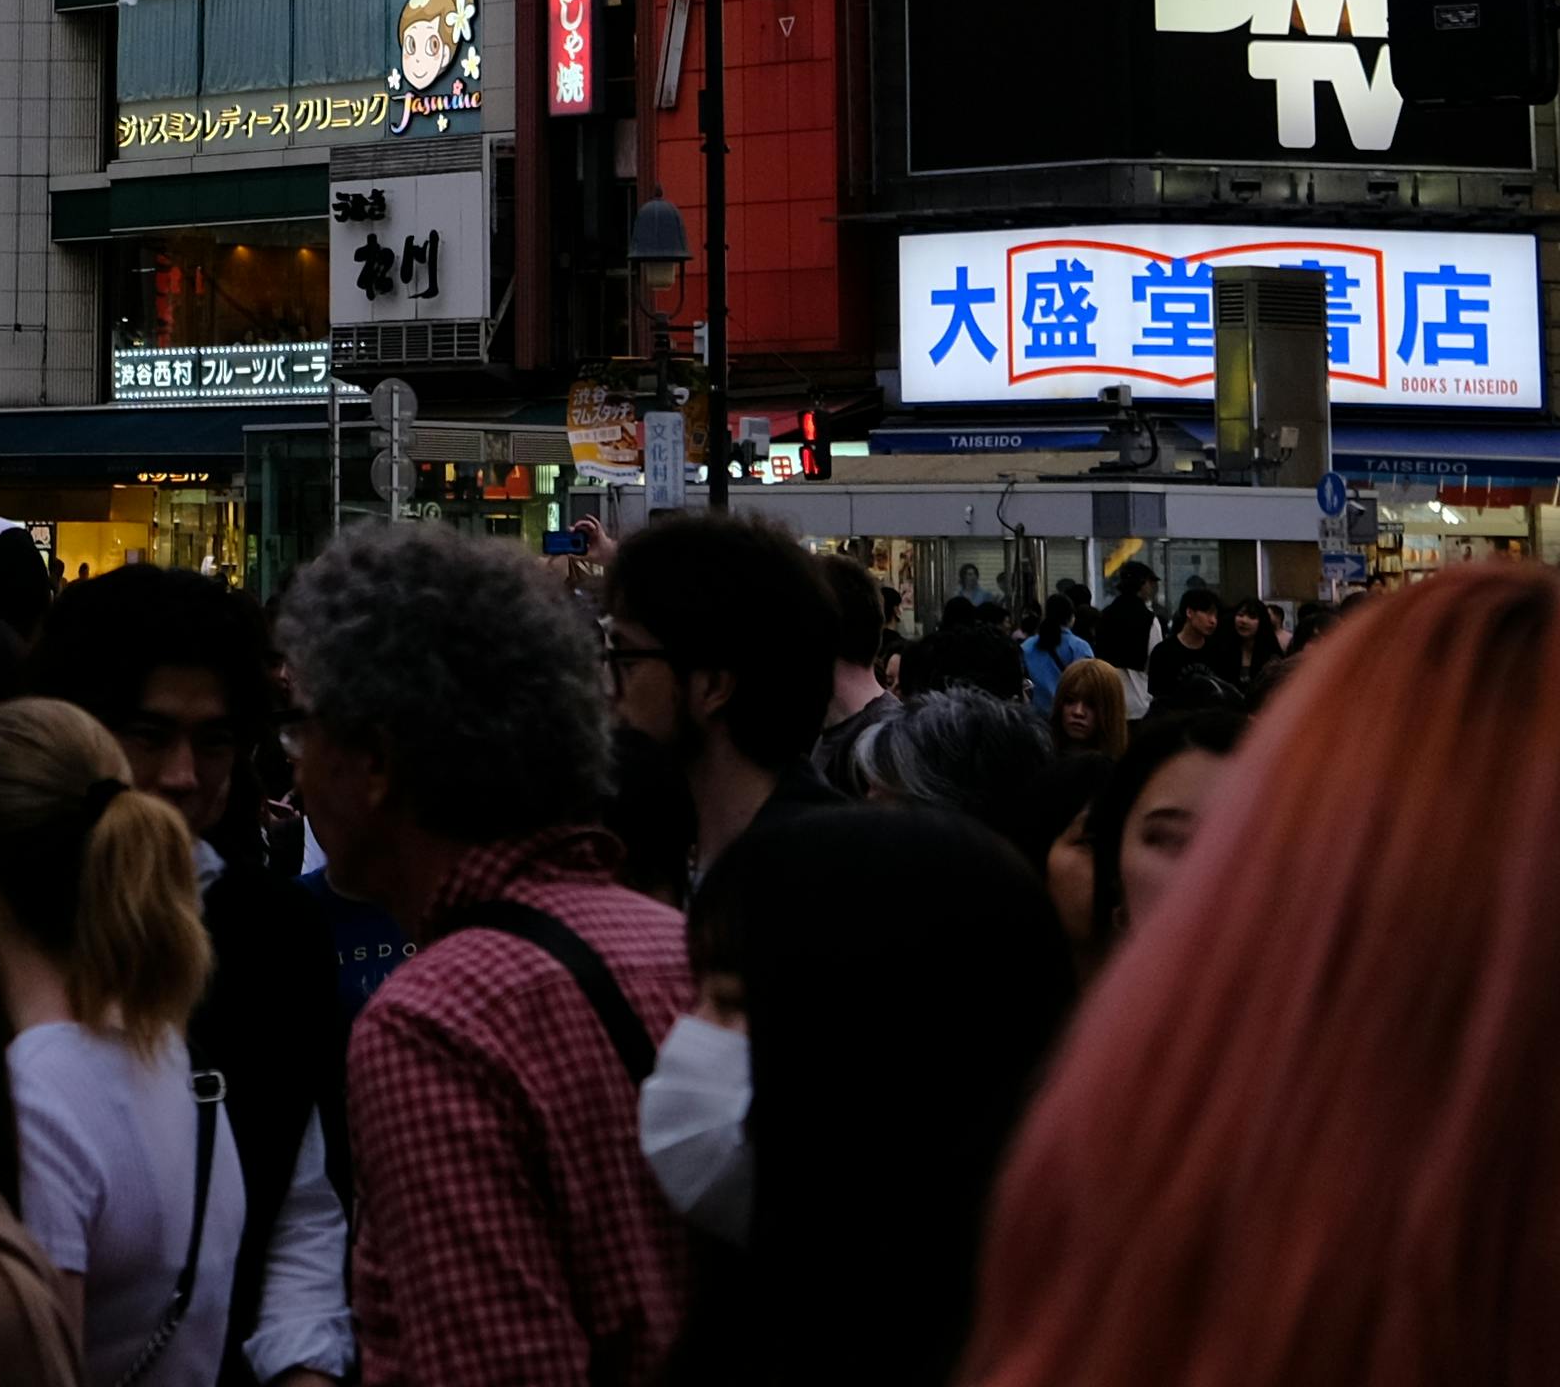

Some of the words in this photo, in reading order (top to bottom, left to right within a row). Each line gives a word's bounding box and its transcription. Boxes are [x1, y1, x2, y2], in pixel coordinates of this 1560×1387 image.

[1248, 41, 1404, 151] TV
[390, 89, 481, 136] Jasmine
[353, 230, 440, 300] 松川
[120, 357, 191, 388] 渋谷西村
[1401, 377, 1447, 395] BOOKS
[1454, 378, 1519, 396] TAISEIDO
[949, 435, 1022, 448] TAISEIDO
[1364, 460, 1468, 474] TAISEIDO
